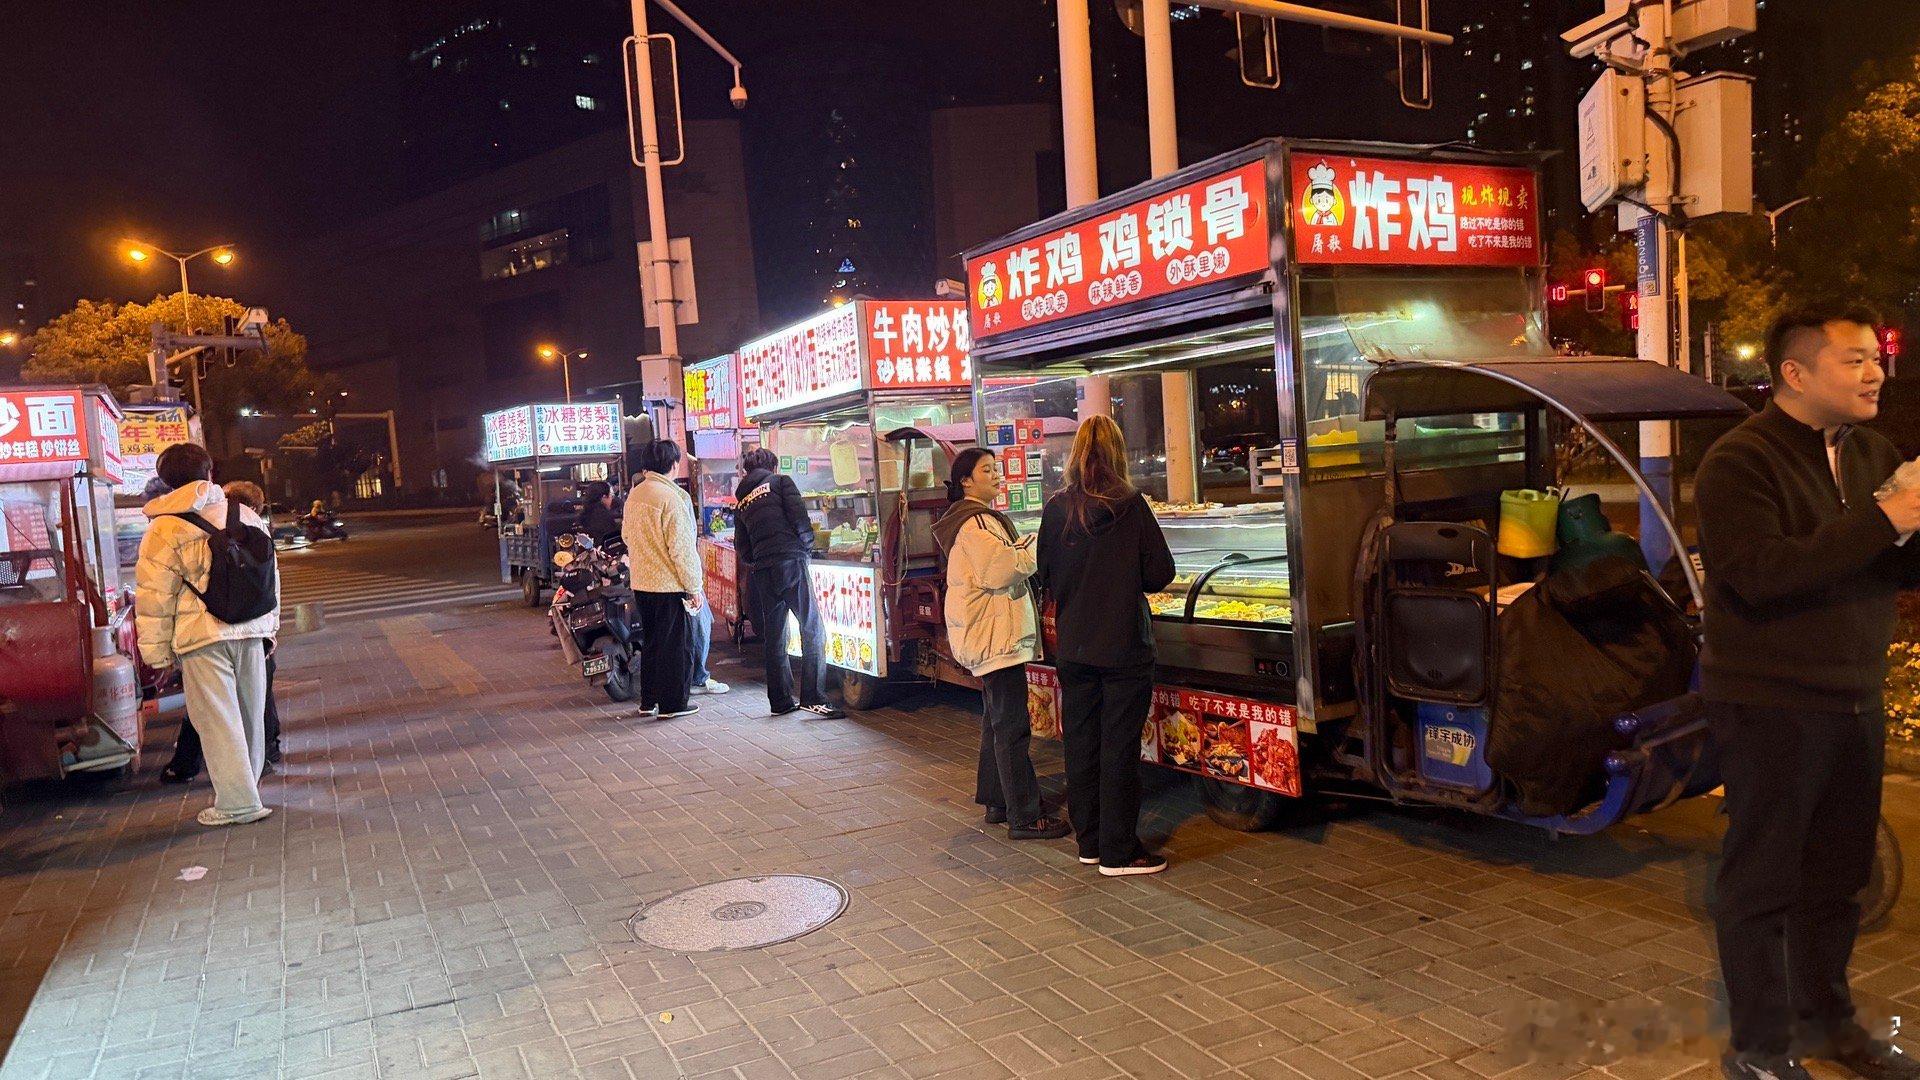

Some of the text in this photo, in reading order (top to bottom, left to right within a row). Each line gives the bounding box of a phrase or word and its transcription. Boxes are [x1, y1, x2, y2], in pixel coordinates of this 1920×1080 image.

[1461, 184, 1528, 210] 现炸现卖
[1349, 170, 1457, 252] 炸鸡
[1460, 216, 1525, 231] 路过不吃是你的错
[1005, 175, 1249, 300] 炸鸡 鸡锁骨
[1468, 235, 1532, 249] 吃了不来是我的错
[1169, 249, 1228, 282] 外酥里嫩
[1089, 274, 1141, 303] 麻辣鲜香
[1552, 286, 1566, 301] 10
[1022, 293, 1067, 319] 现炸现卖
[544, 406, 610, 424] 冰糖烤梨
[545, 424, 611, 442] 八宝龙粥
[1188, 695, 1292, 726] 吃了不来是我的错
